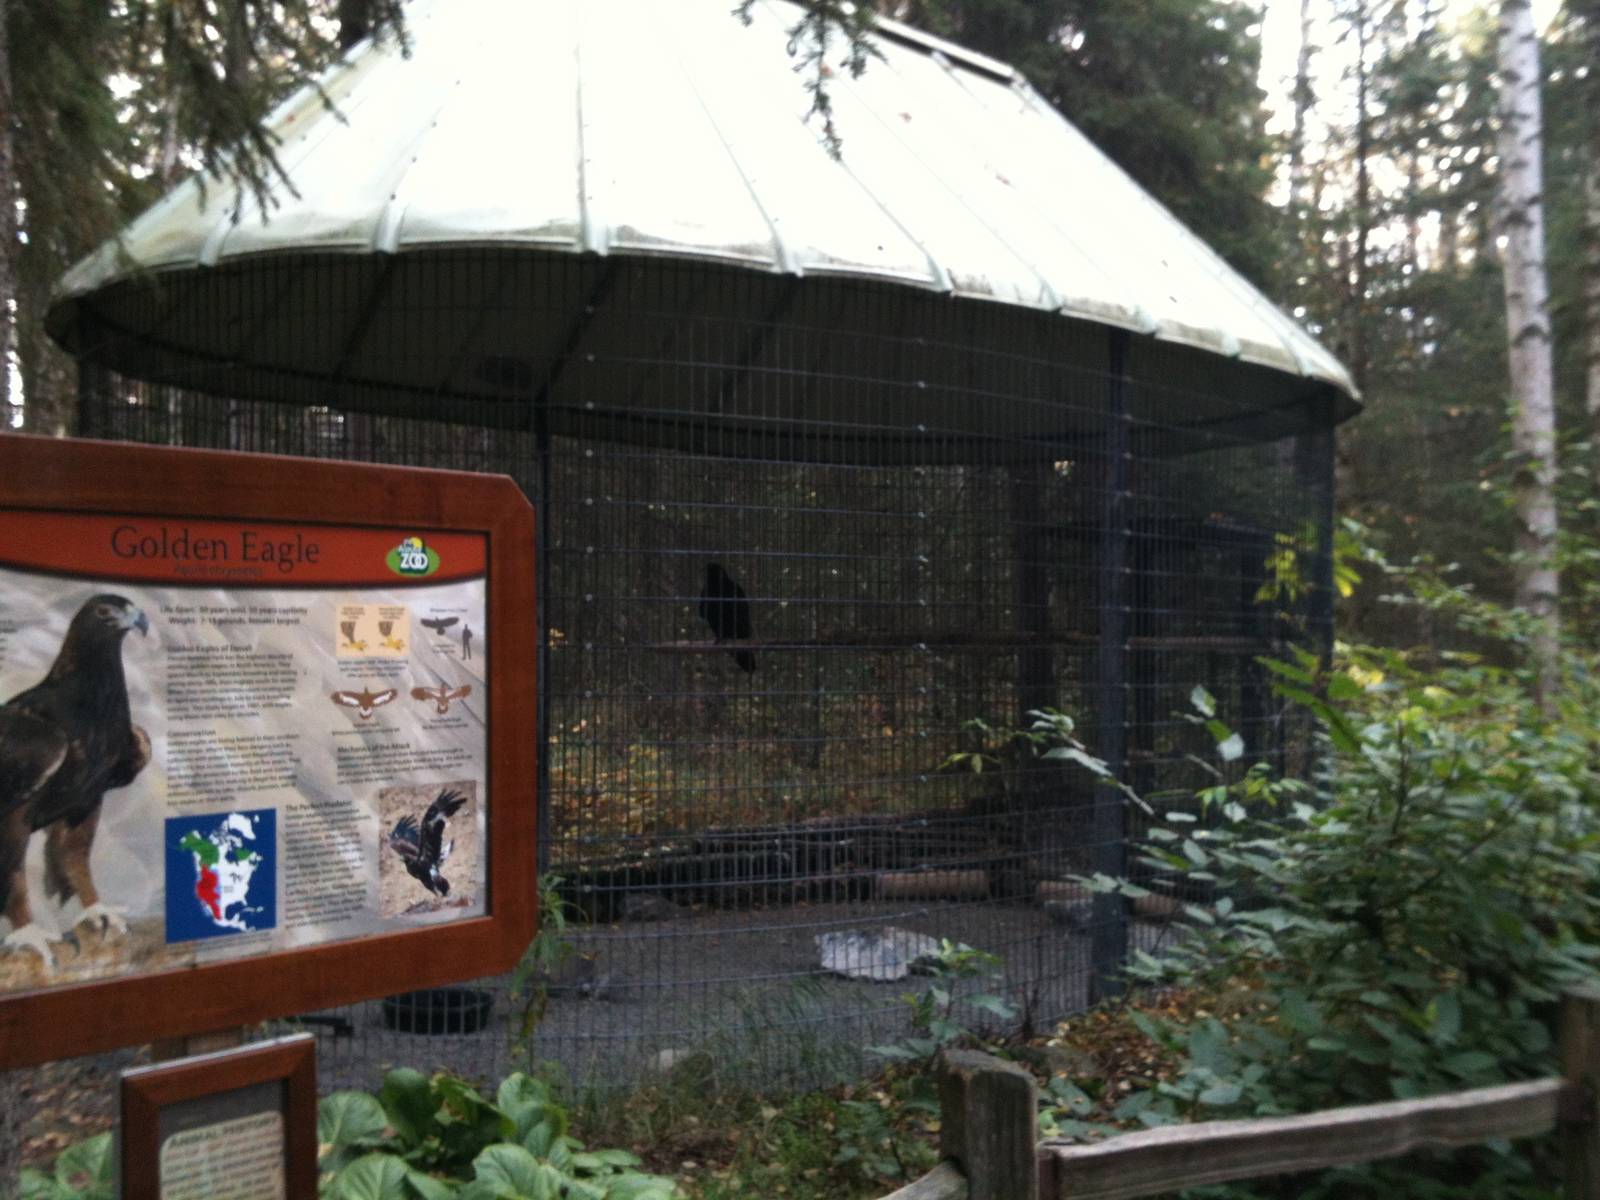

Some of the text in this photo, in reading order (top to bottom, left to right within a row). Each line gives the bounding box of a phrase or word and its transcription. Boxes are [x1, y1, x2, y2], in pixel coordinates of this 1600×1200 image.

[111, 525, 320, 574] Golden Eagle
[400, 553, 429, 571] ZOO
